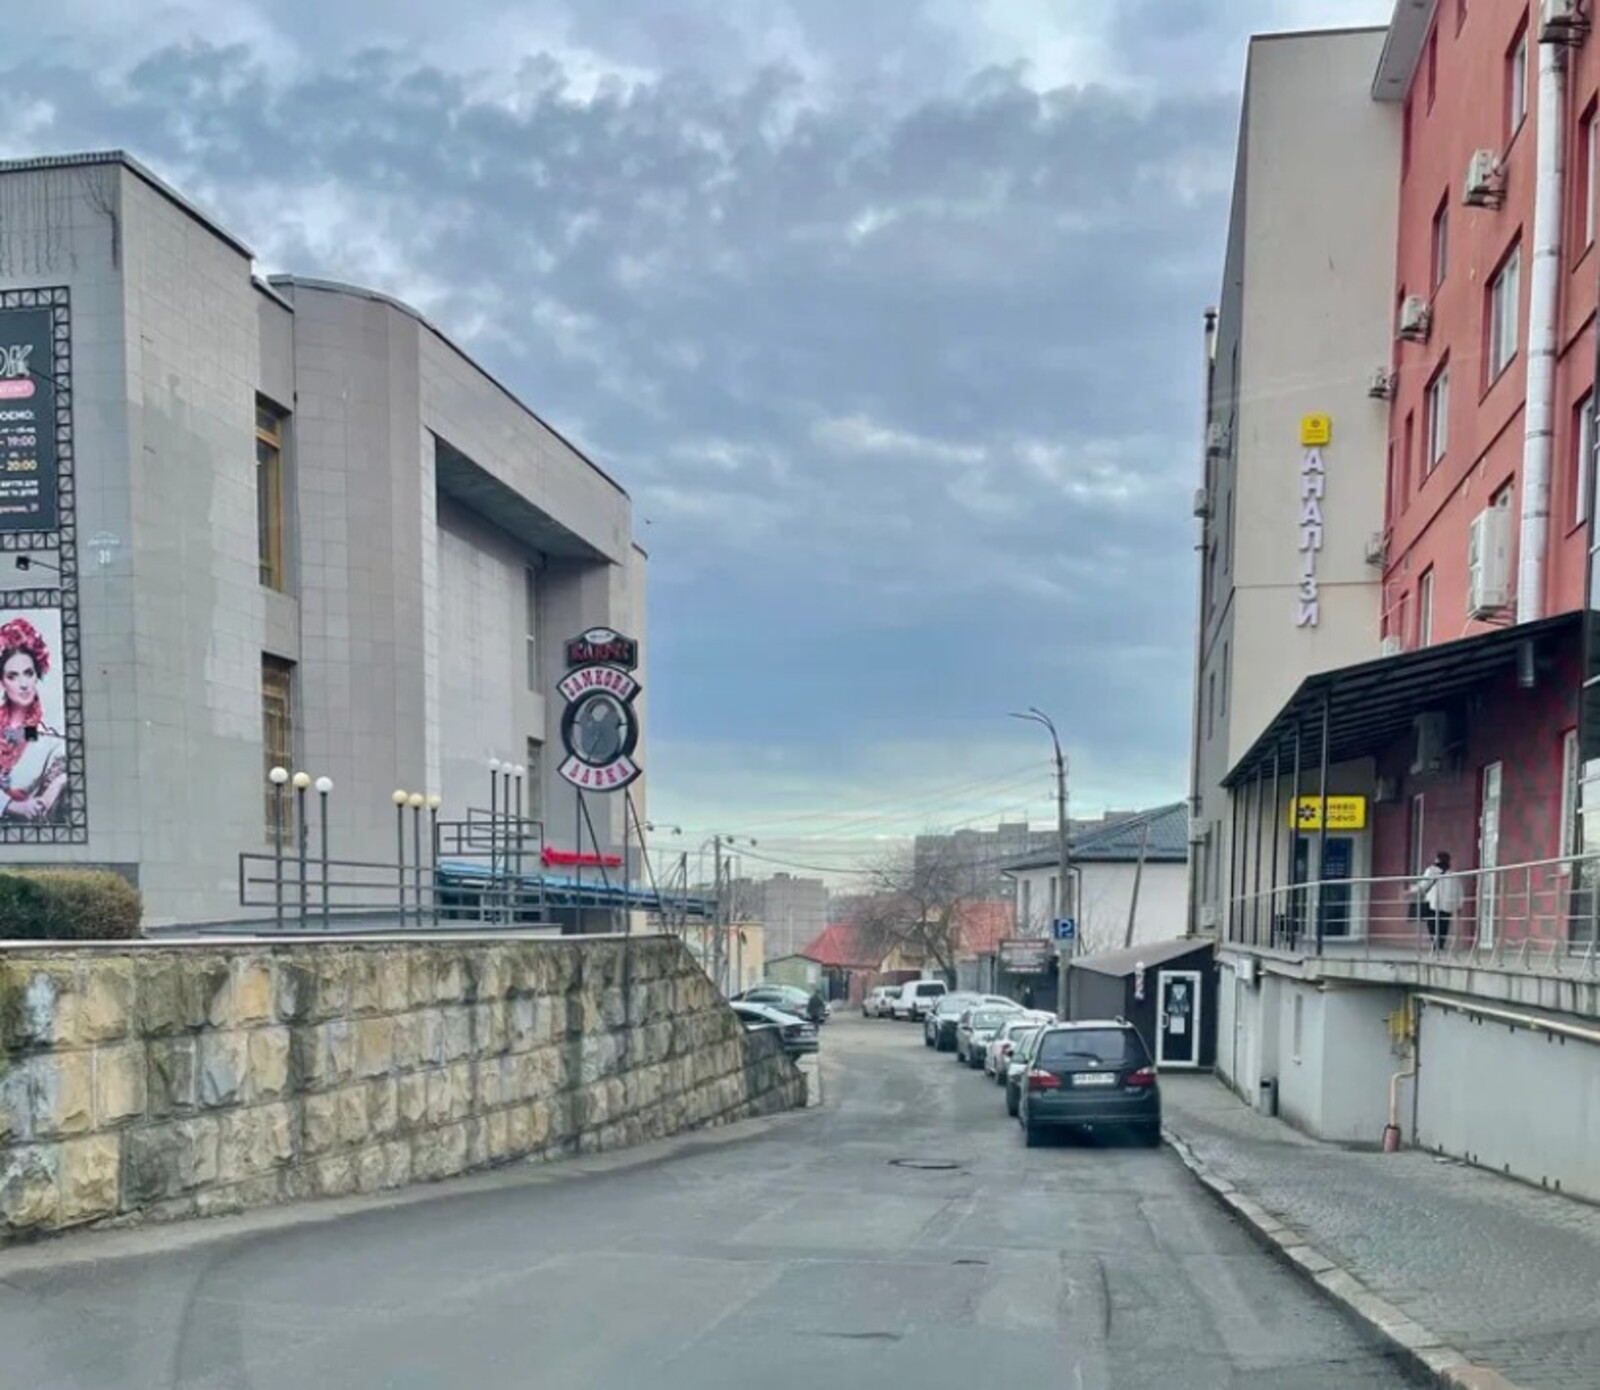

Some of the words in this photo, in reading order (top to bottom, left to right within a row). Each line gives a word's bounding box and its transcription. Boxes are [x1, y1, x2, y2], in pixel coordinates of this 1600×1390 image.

[7, 460, 37, 471] 20:00
[1298, 448, 1325, 628] АНАЛІЗИ
[563, 669, 631, 697] ЗАМКОВА
[568, 762, 629, 786] ЛАВКА
